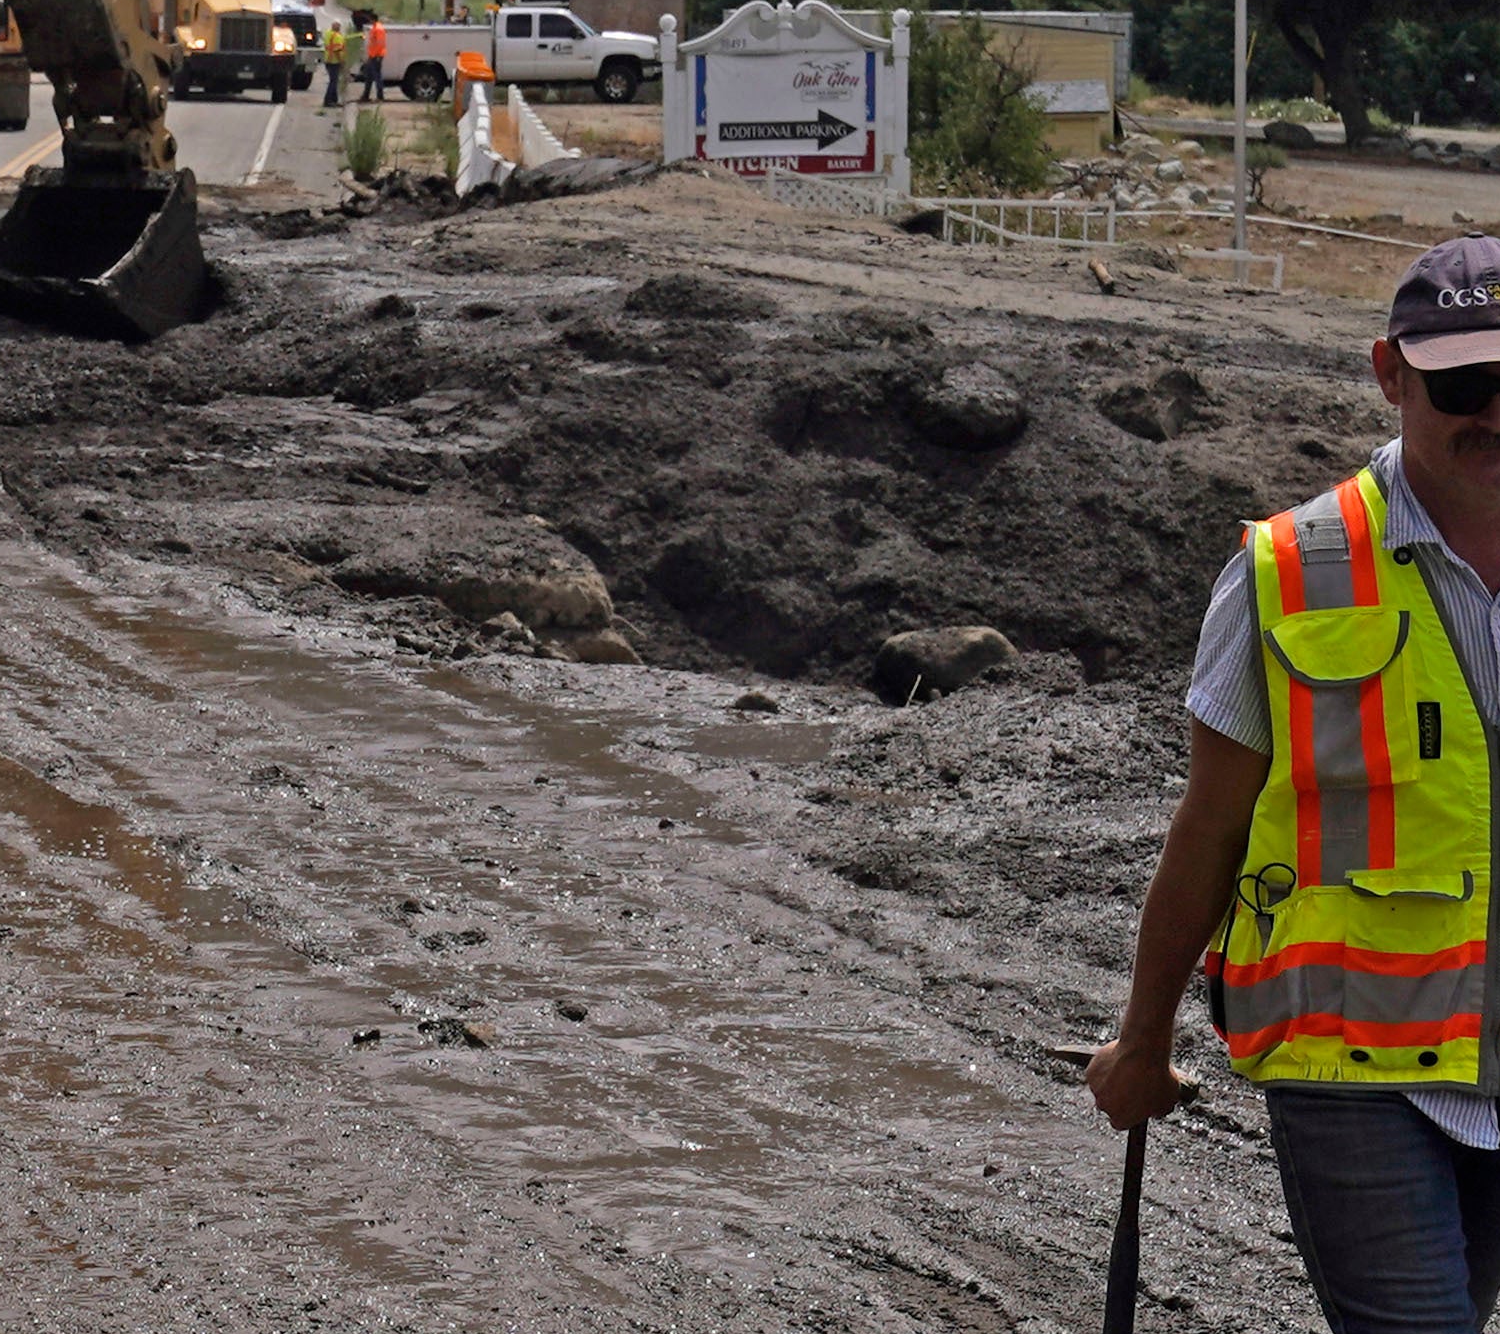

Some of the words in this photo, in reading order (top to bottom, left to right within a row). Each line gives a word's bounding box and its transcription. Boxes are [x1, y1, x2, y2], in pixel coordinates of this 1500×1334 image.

[793, 71, 822, 89] Oak
[827, 70, 861, 88] Glen
[721, 125, 792, 139] ADDITIONAL
[796, 124, 848, 138] PARKING
[827, 159, 863, 169] BAKERY
[1437, 287, 1489, 308] CGS
